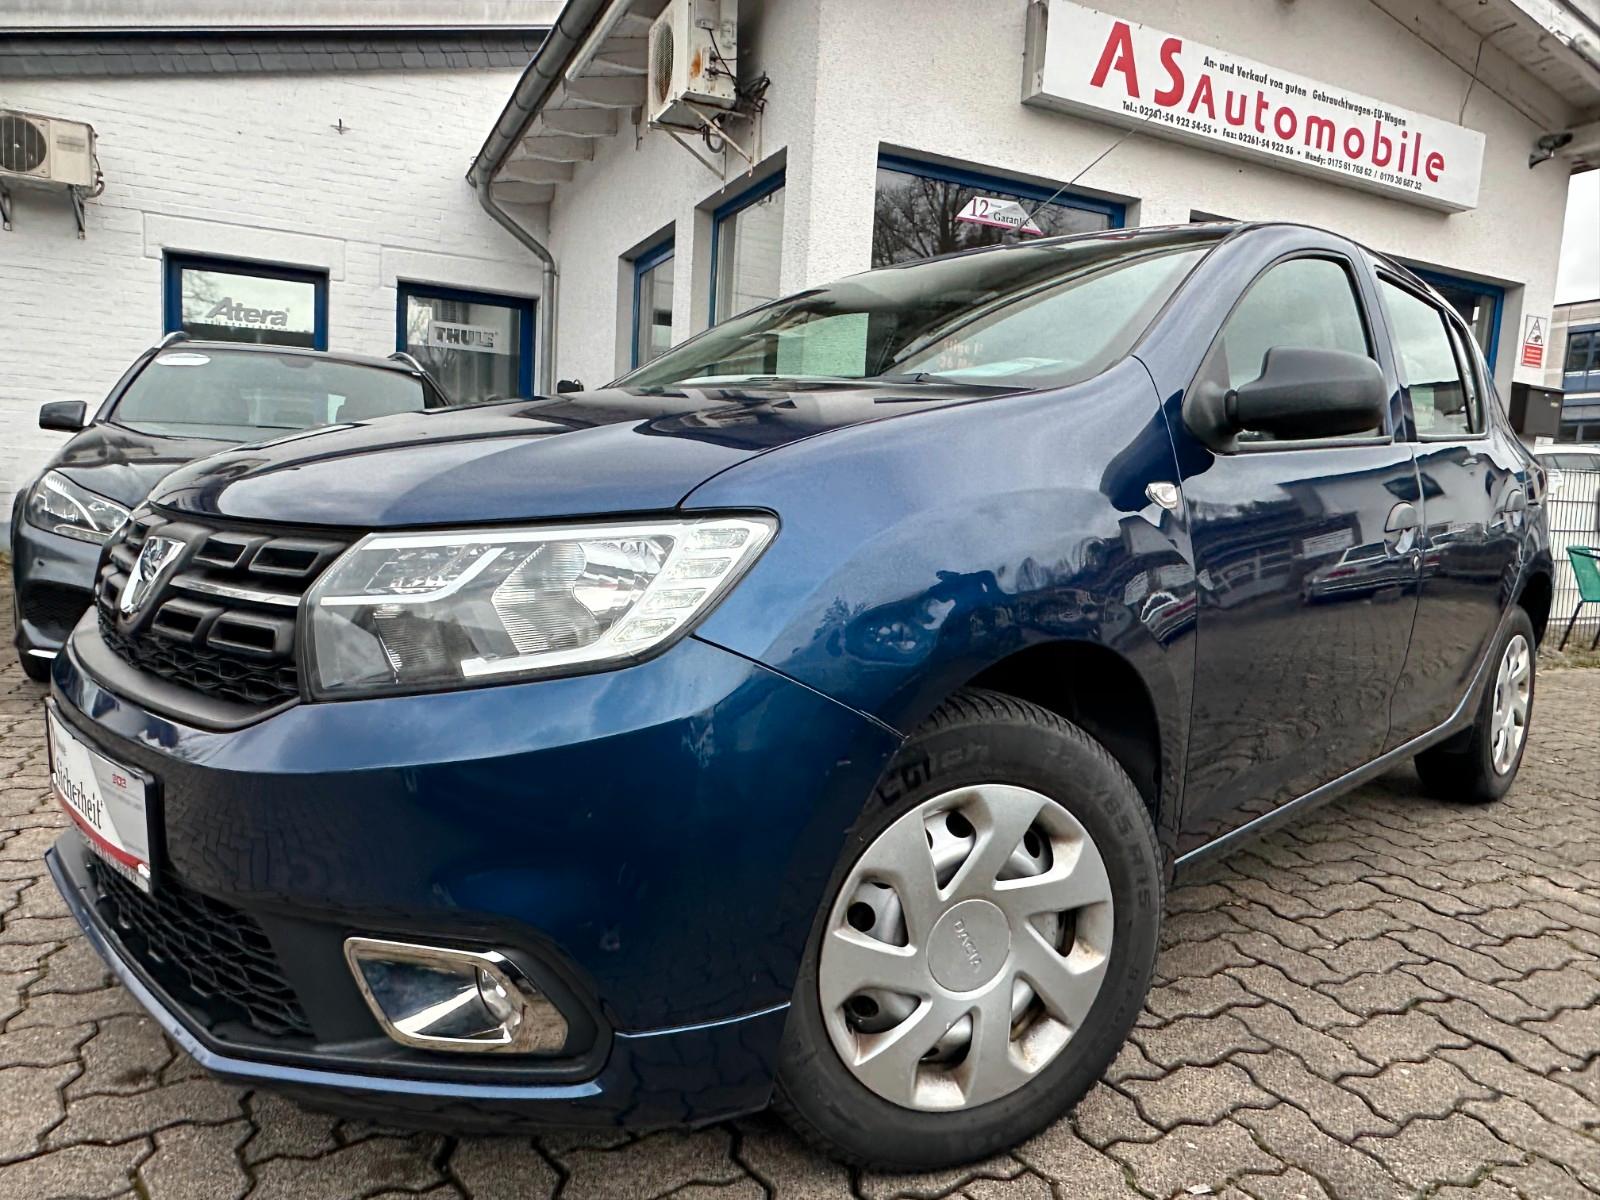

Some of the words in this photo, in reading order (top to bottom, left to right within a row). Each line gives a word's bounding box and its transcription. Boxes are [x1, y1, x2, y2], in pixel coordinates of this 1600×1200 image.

[1203, 56, 1218, 69] An-
[1220, 64, 1235, 75] und
[1237, 65, 1268, 84] Verkauf
[1270, 78, 1284, 90] von
[1285, 81, 1307, 96] guten
[1122, 101, 1138, 114] Tel.:
[1175, 116, 1190, 128] 922
[1222, 128, 1237, 140] Fax:
[1271, 141, 1284, 153] 922
[969, 198, 989, 218] 12
[206, 297, 289, 326] Atera
[434, 326, 494, 348] THULE
